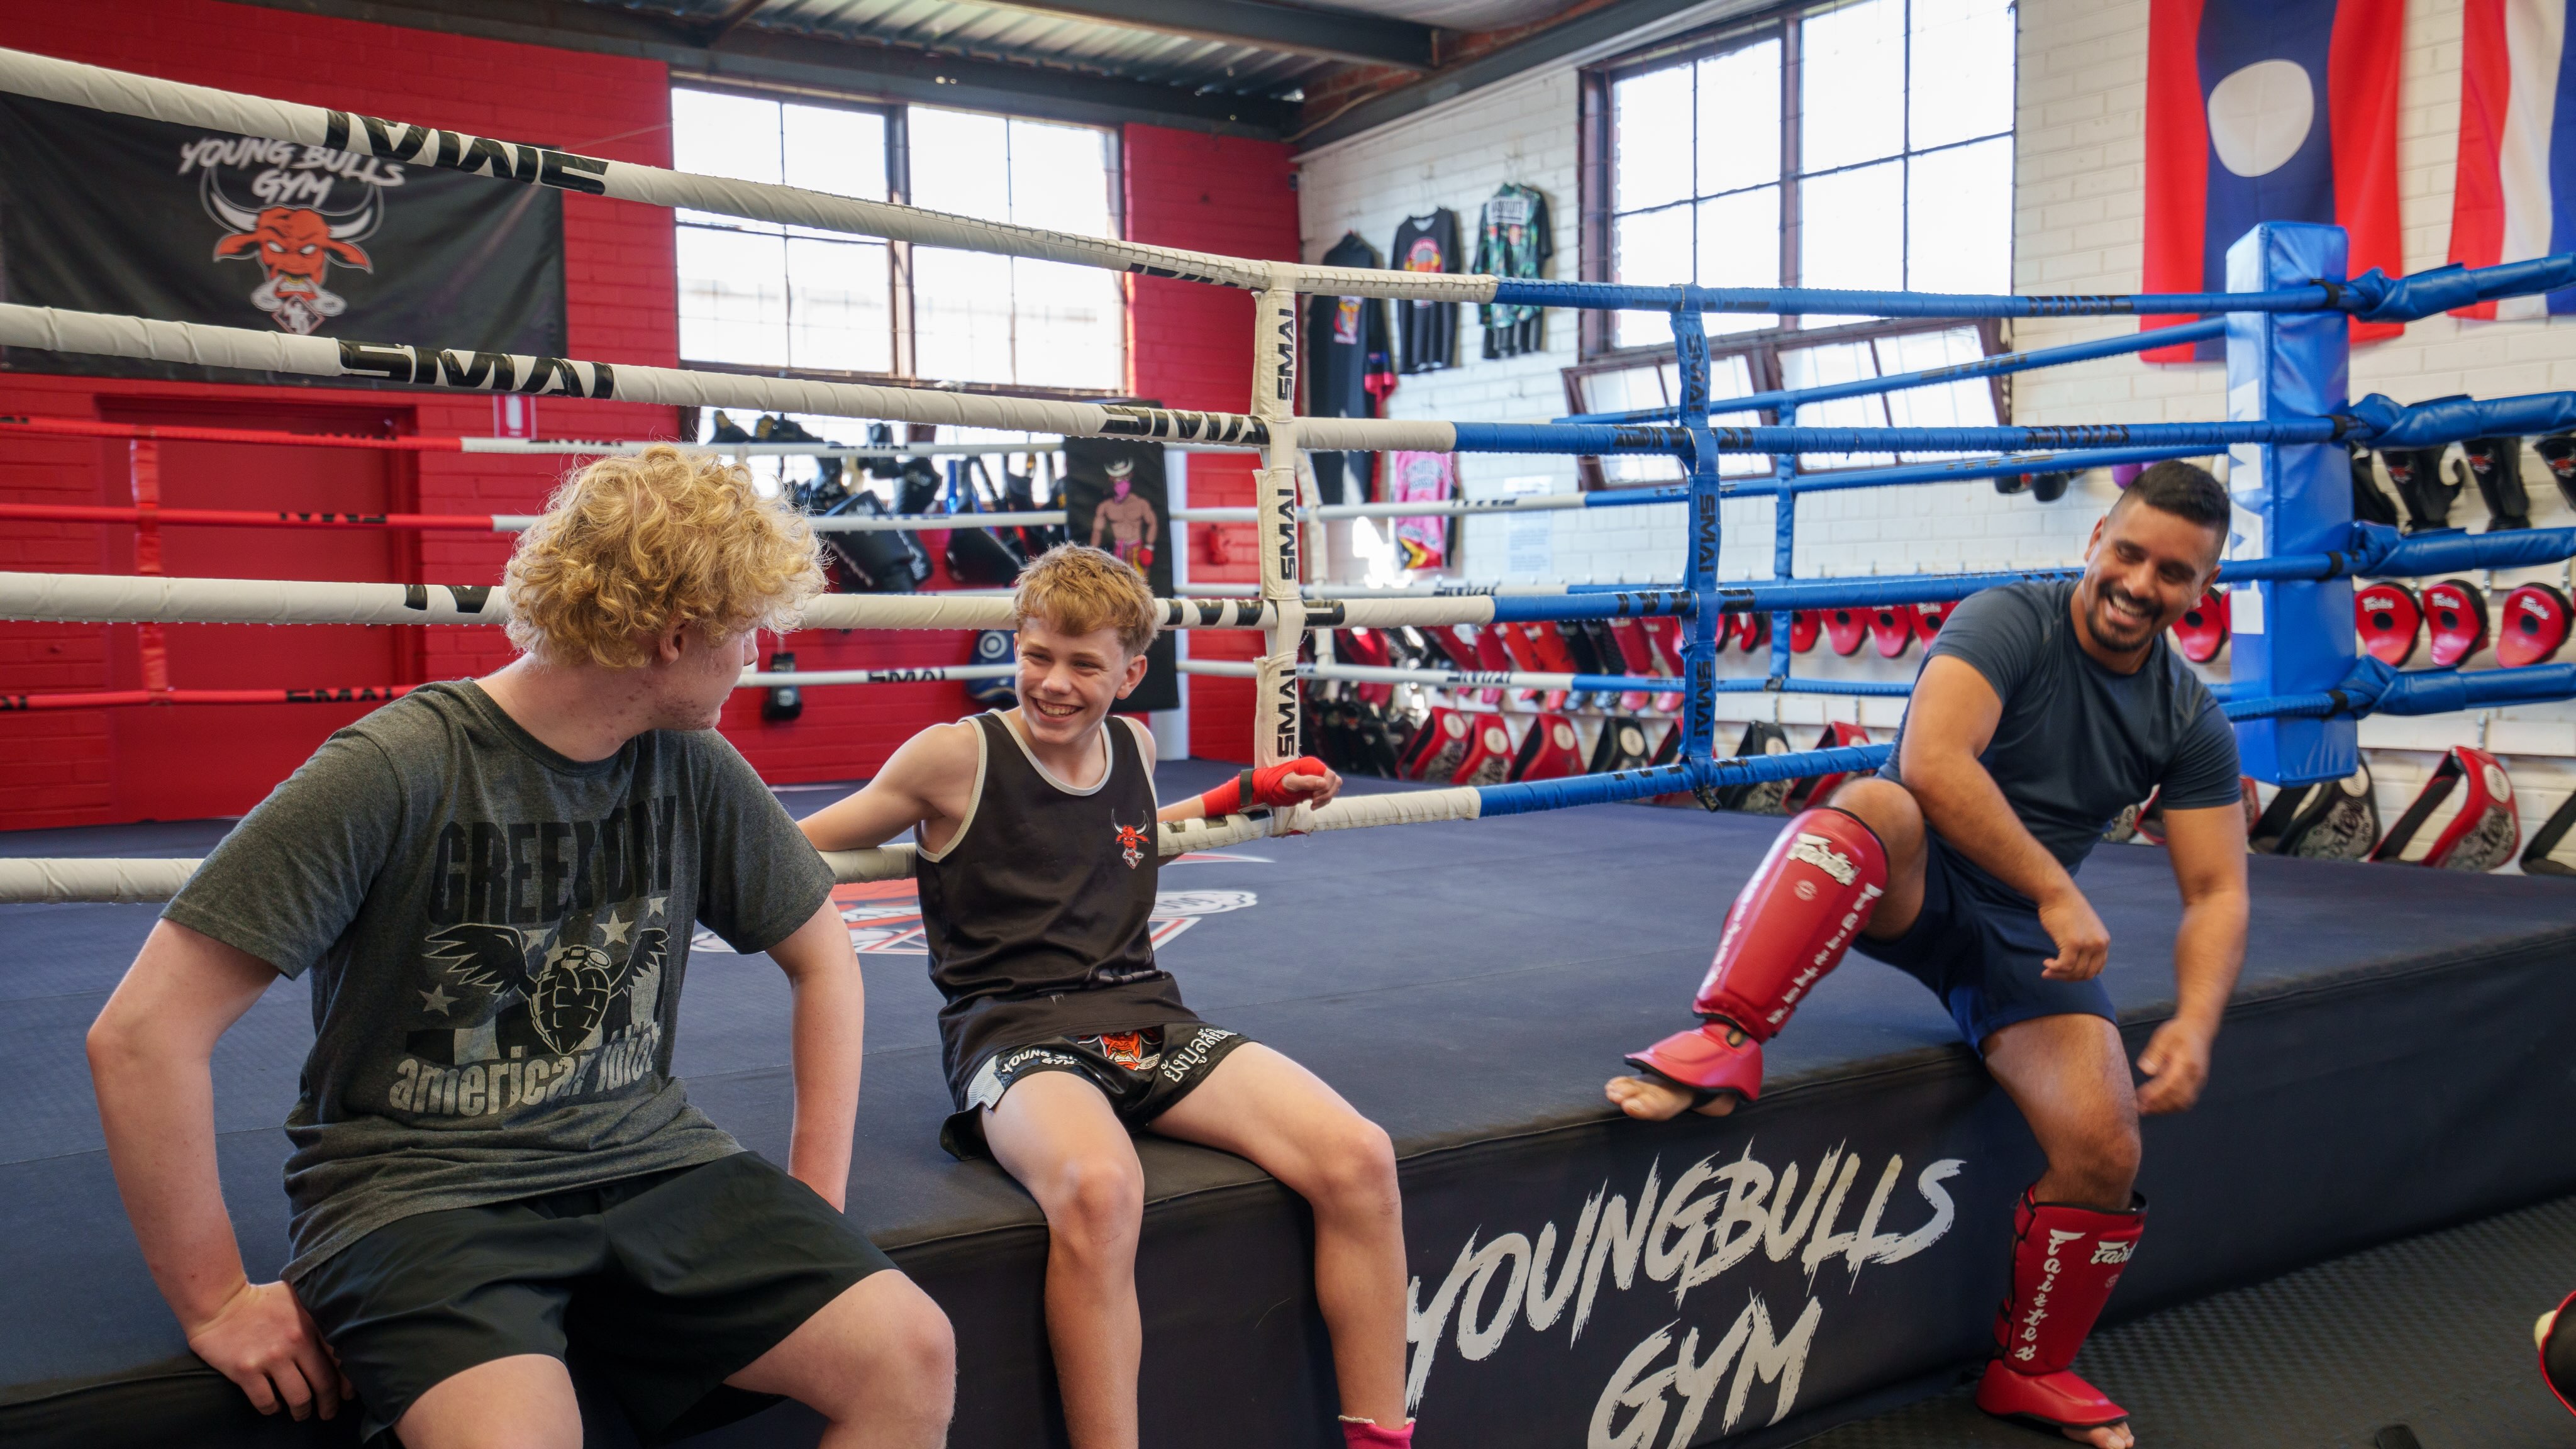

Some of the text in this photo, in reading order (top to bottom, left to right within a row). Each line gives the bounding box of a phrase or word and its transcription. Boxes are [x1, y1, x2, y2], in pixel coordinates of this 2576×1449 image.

[179, 136, 406, 186] YOUNG BULLS
[252, 169, 335, 208] GYM
[1277, 308, 1294, 401] SMAI
[1098, 404, 1270, 445] SMA
[1277, 489, 1296, 580] SMAI
[1699, 494, 1716, 572] SMAI
[1277, 669, 1296, 758] SMAI
[1001, 1048, 1051, 1073] YOUNG
[1587, 1286, 1823, 1449] GYM
